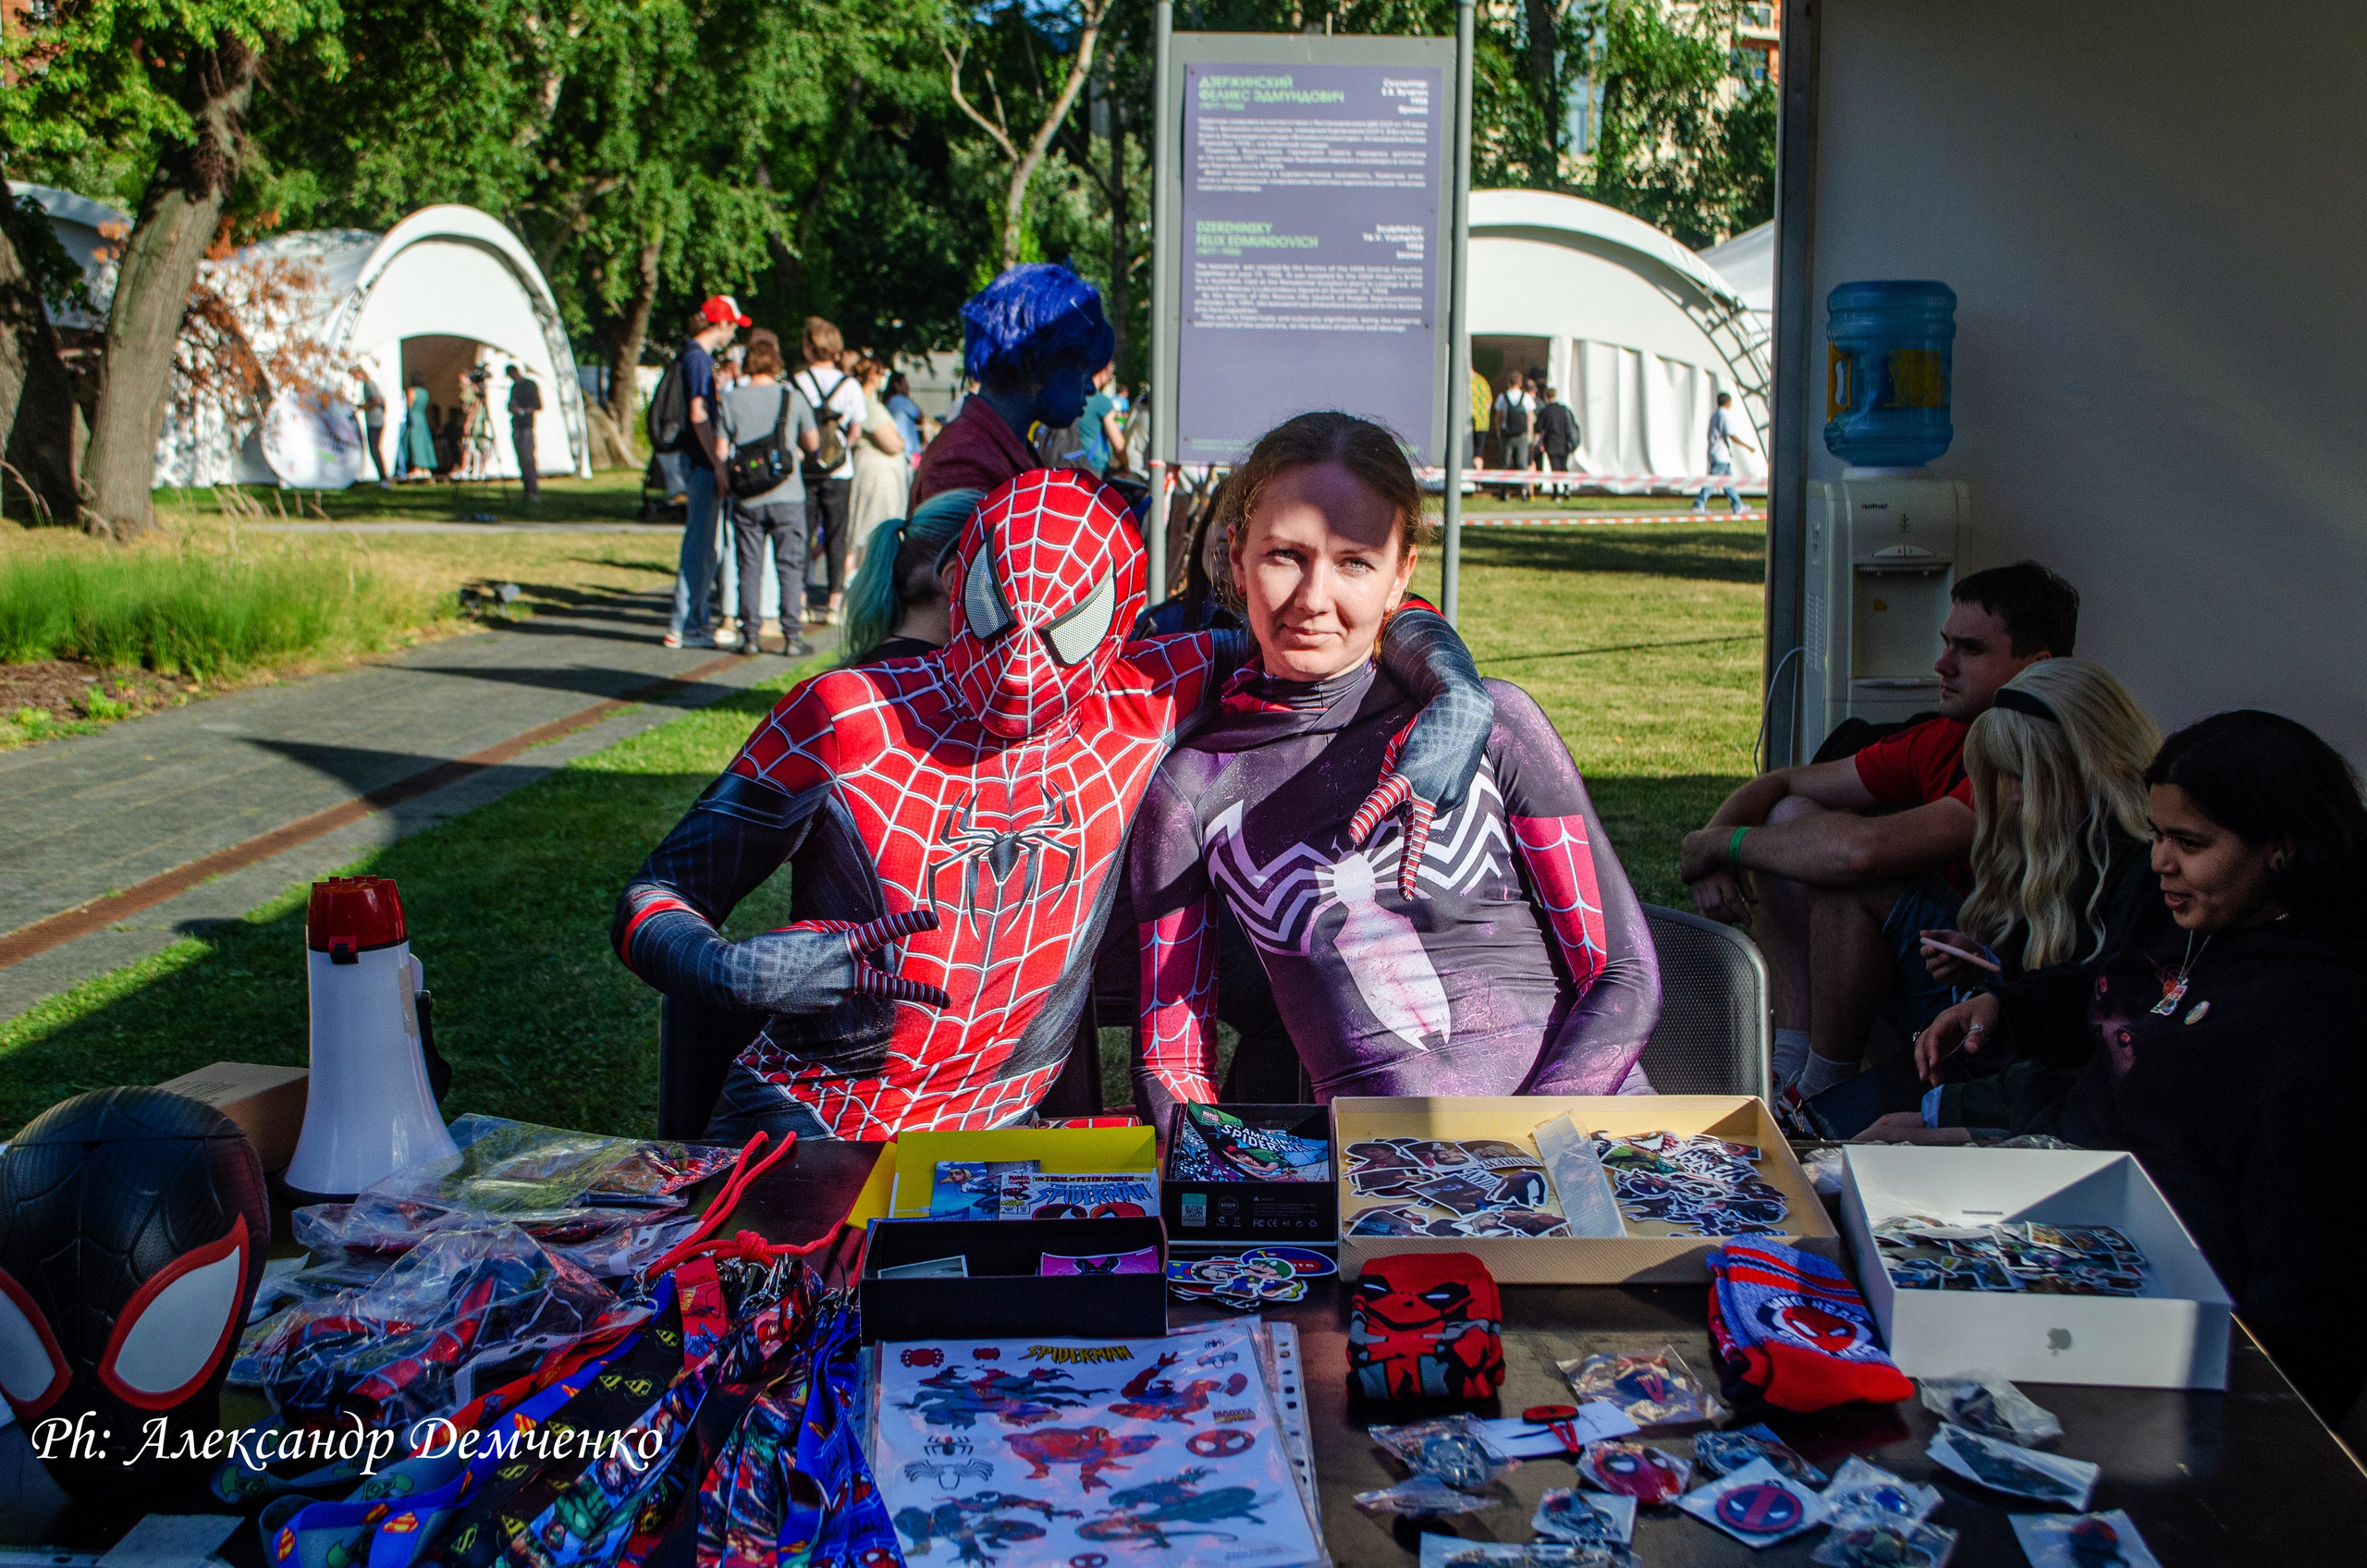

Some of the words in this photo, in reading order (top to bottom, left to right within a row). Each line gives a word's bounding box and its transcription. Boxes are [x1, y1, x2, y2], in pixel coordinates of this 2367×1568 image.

[1198, 75, 1293, 89] ДЗЕРЖИНСКИЙ
[1198, 88, 1251, 103] ФЕЛИКС
[1253, 90, 1345, 104] ЭДМУНДОВИЧ
[1196, 220, 1273, 234] DZERZHINSKY
[1196, 233, 1225, 248] FELIX
[1226, 234, 1318, 250] EDMUNDOVICH
